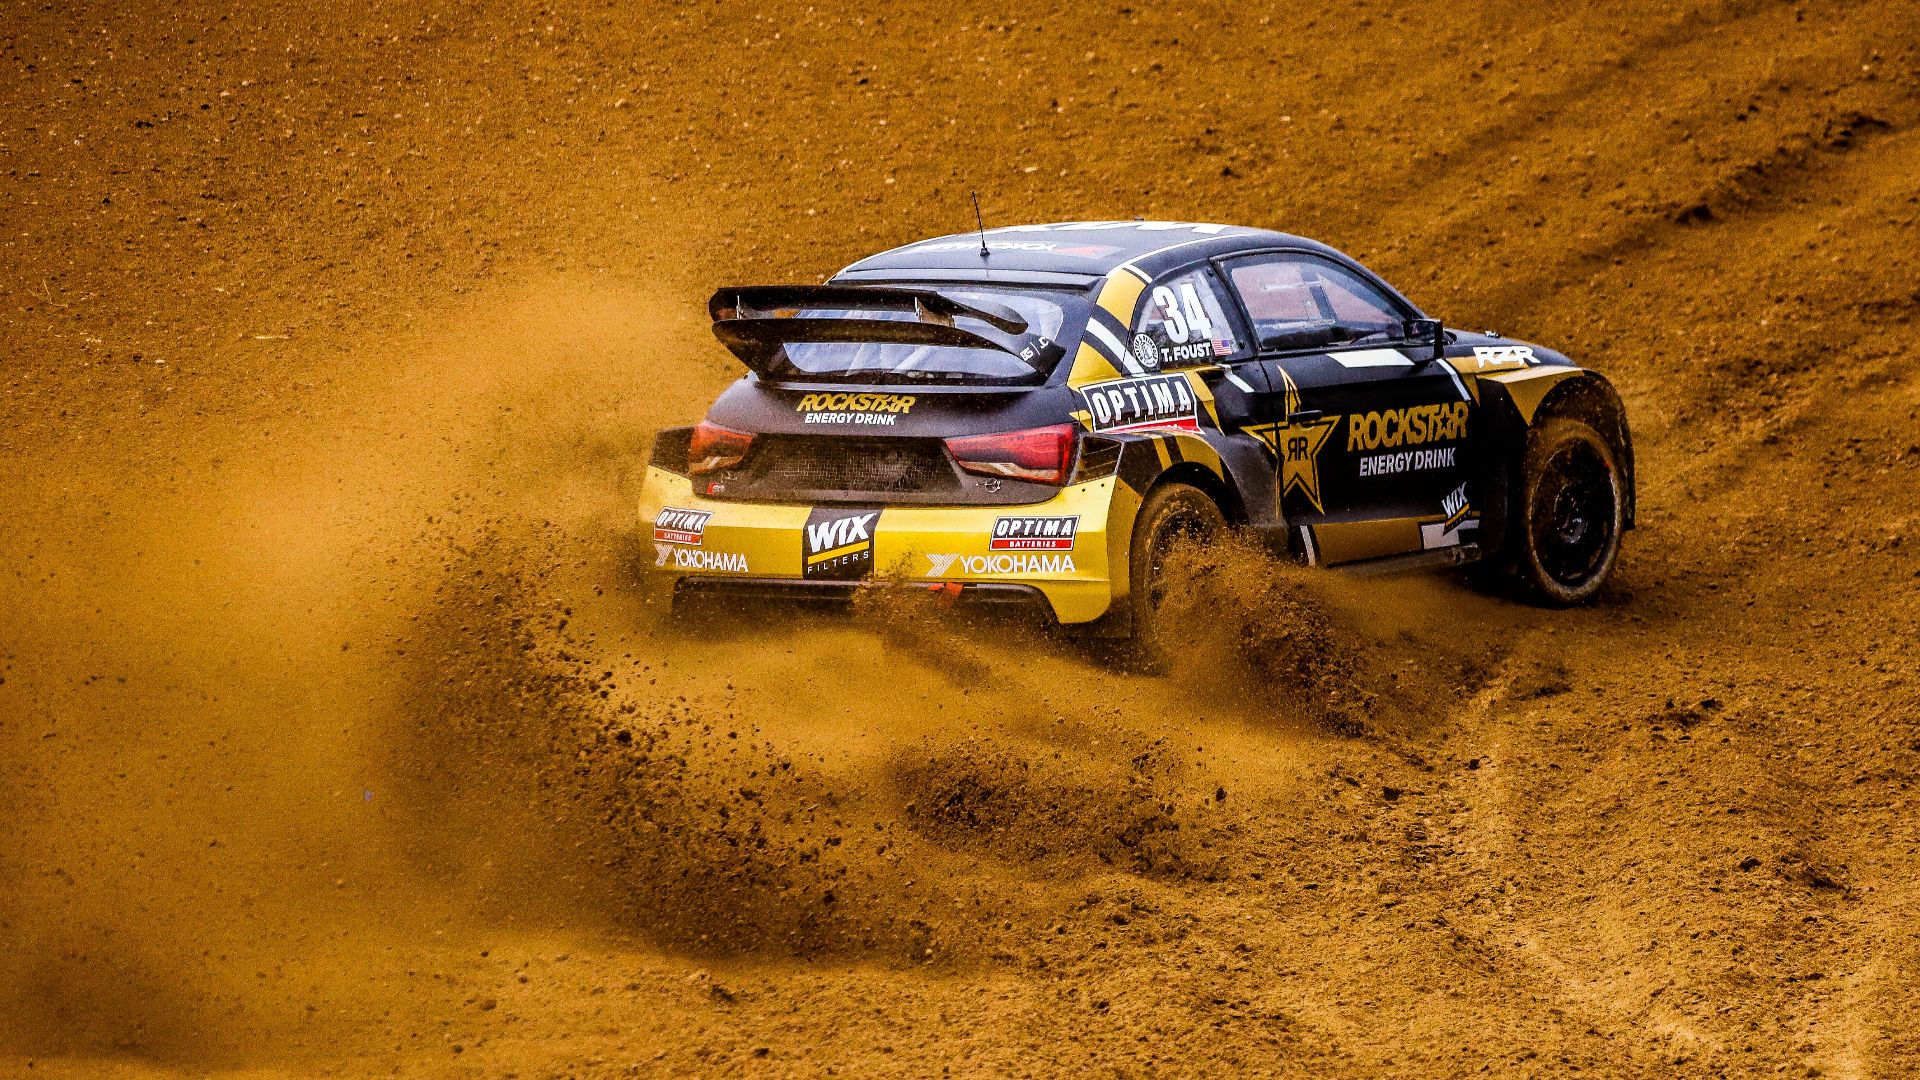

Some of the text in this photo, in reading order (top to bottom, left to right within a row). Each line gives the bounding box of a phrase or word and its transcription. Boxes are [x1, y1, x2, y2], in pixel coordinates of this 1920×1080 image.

[1152, 283, 1212, 344] 34
[796, 393, 916, 414] ROCKSTAR
[1092, 381, 1192, 424] OPTIMA
[805, 412, 896, 426] ENERGY DRINK
[1347, 401, 1469, 452] ROCKSTAR
[1359, 447, 1457, 477] ENERGY DRINK
[1441, 481, 1468, 519] WIX
[656, 511, 707, 531] OPTIMA
[807, 512, 877, 553] WIX
[996, 519, 1072, 536] OPTIMA
[1009, 540, 1056, 548] BATTERIES
[673, 548, 749, 573] YOKOHAMA
[807, 551, 869, 574] FILTERS
[960, 554, 1076, 574] YOKOHAMA
